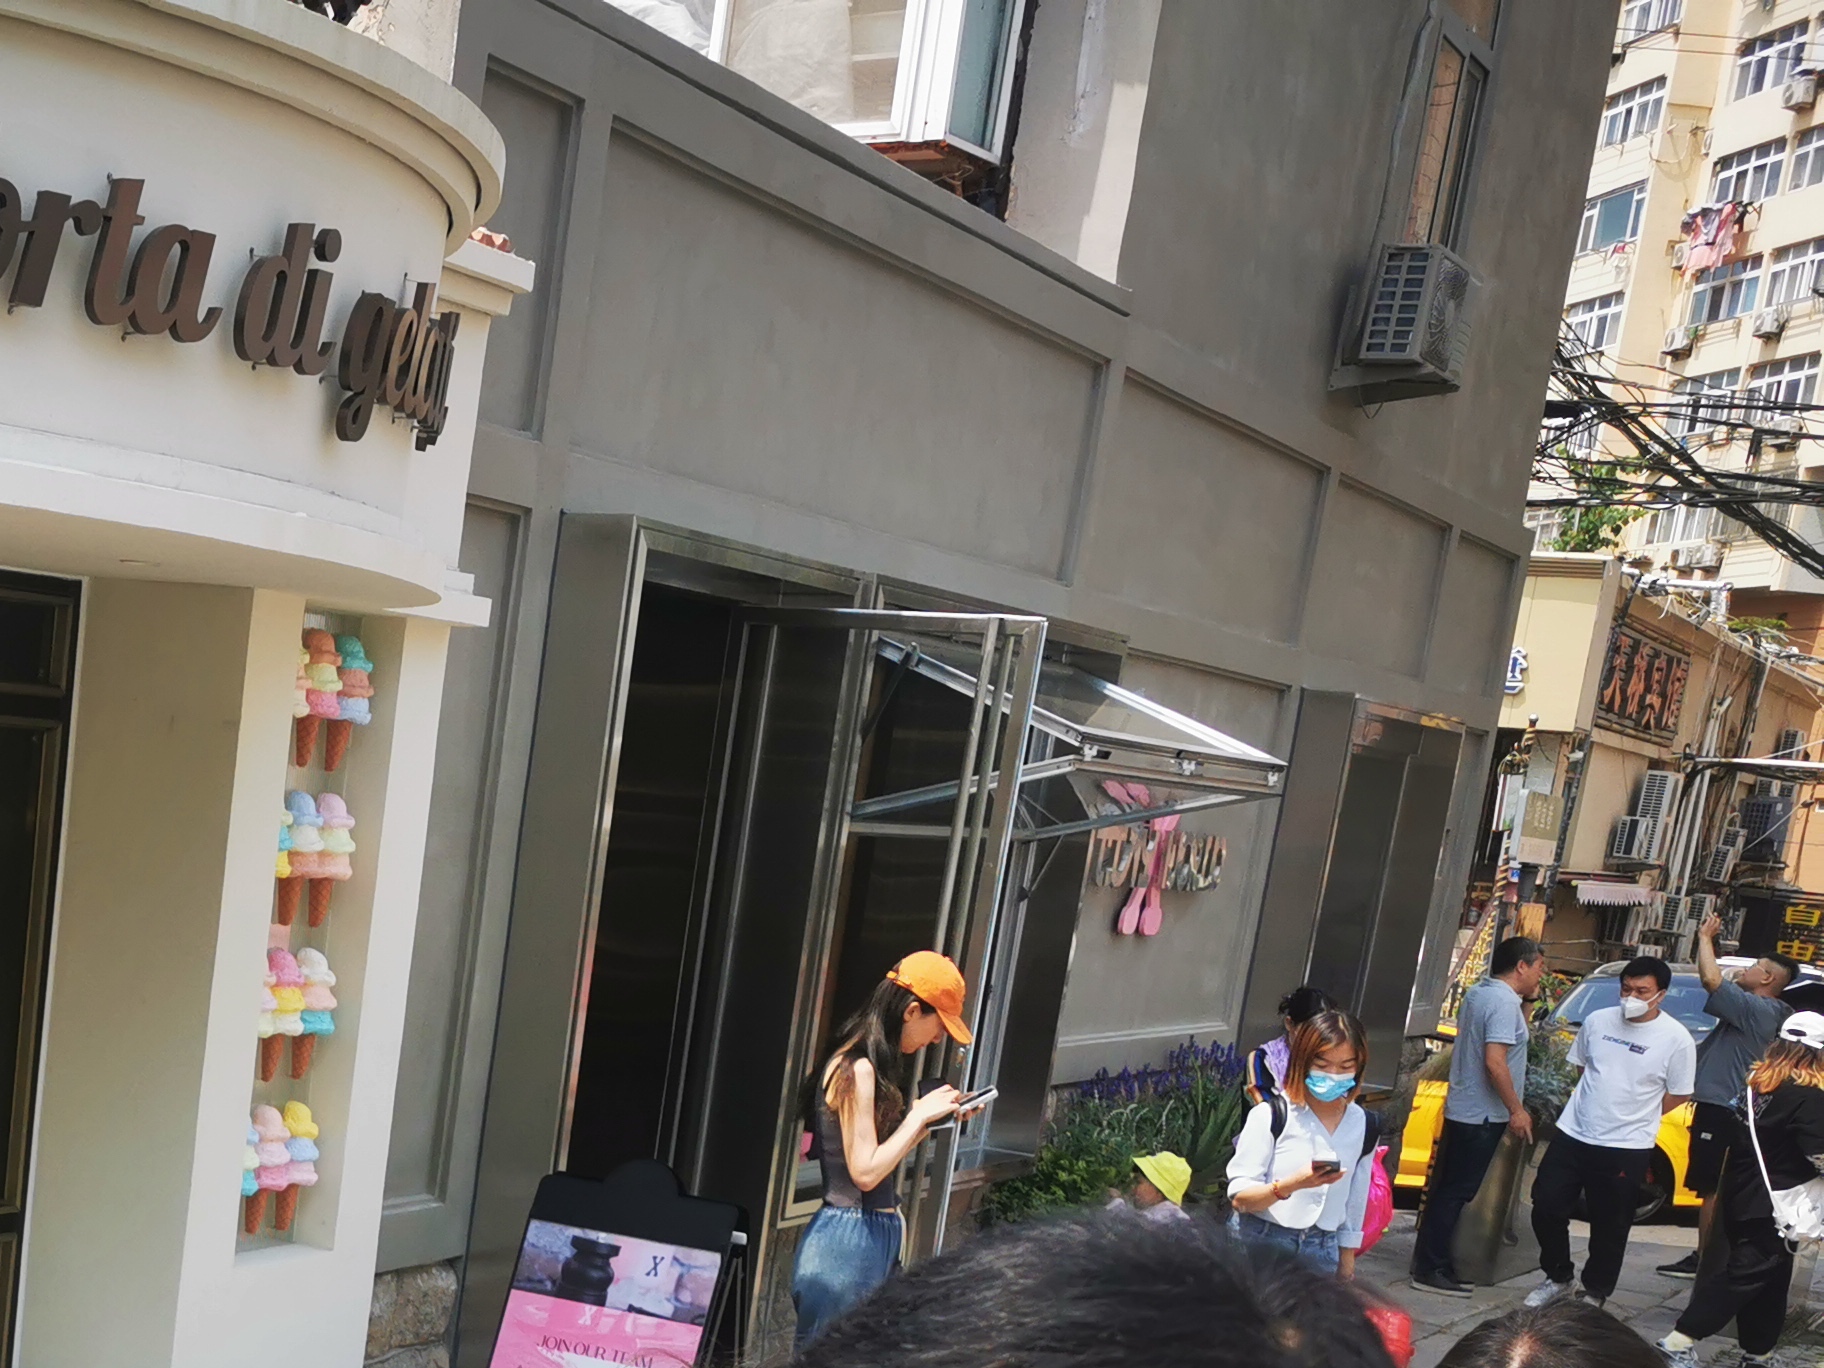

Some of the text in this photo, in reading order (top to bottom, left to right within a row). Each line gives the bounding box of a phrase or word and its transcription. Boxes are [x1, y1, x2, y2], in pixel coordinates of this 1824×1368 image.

[233, 222, 342, 376] di
[537, 1335, 571, 1353] JOIN
[574, 1341, 606, 1360] OUR
